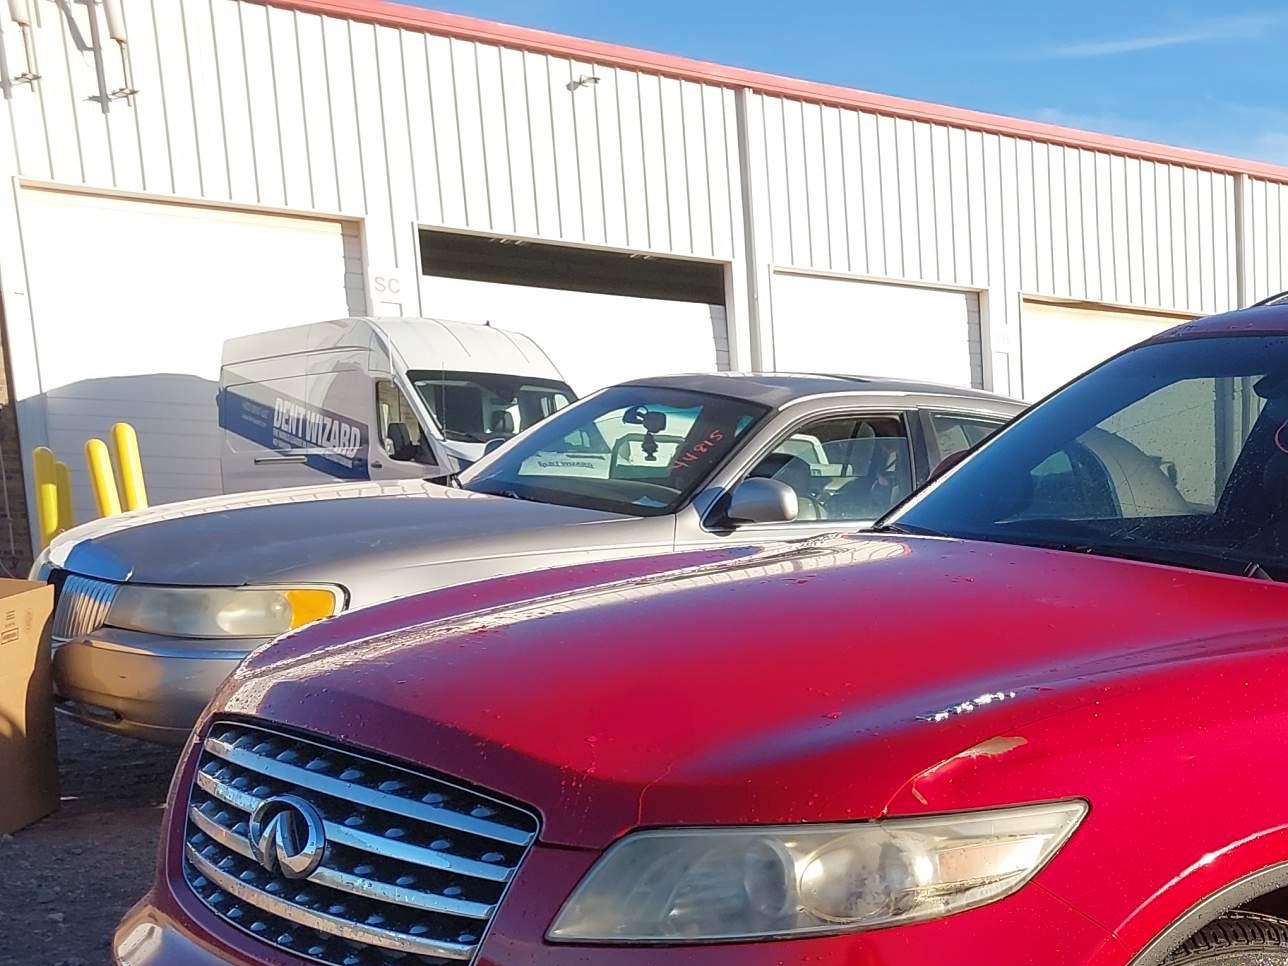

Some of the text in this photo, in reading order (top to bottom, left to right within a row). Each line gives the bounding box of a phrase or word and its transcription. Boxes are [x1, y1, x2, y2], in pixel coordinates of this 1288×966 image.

[374, 275, 401, 294] SC
[273, 397, 306, 438] DENT
[306, 409, 361, 458] WIZARD
